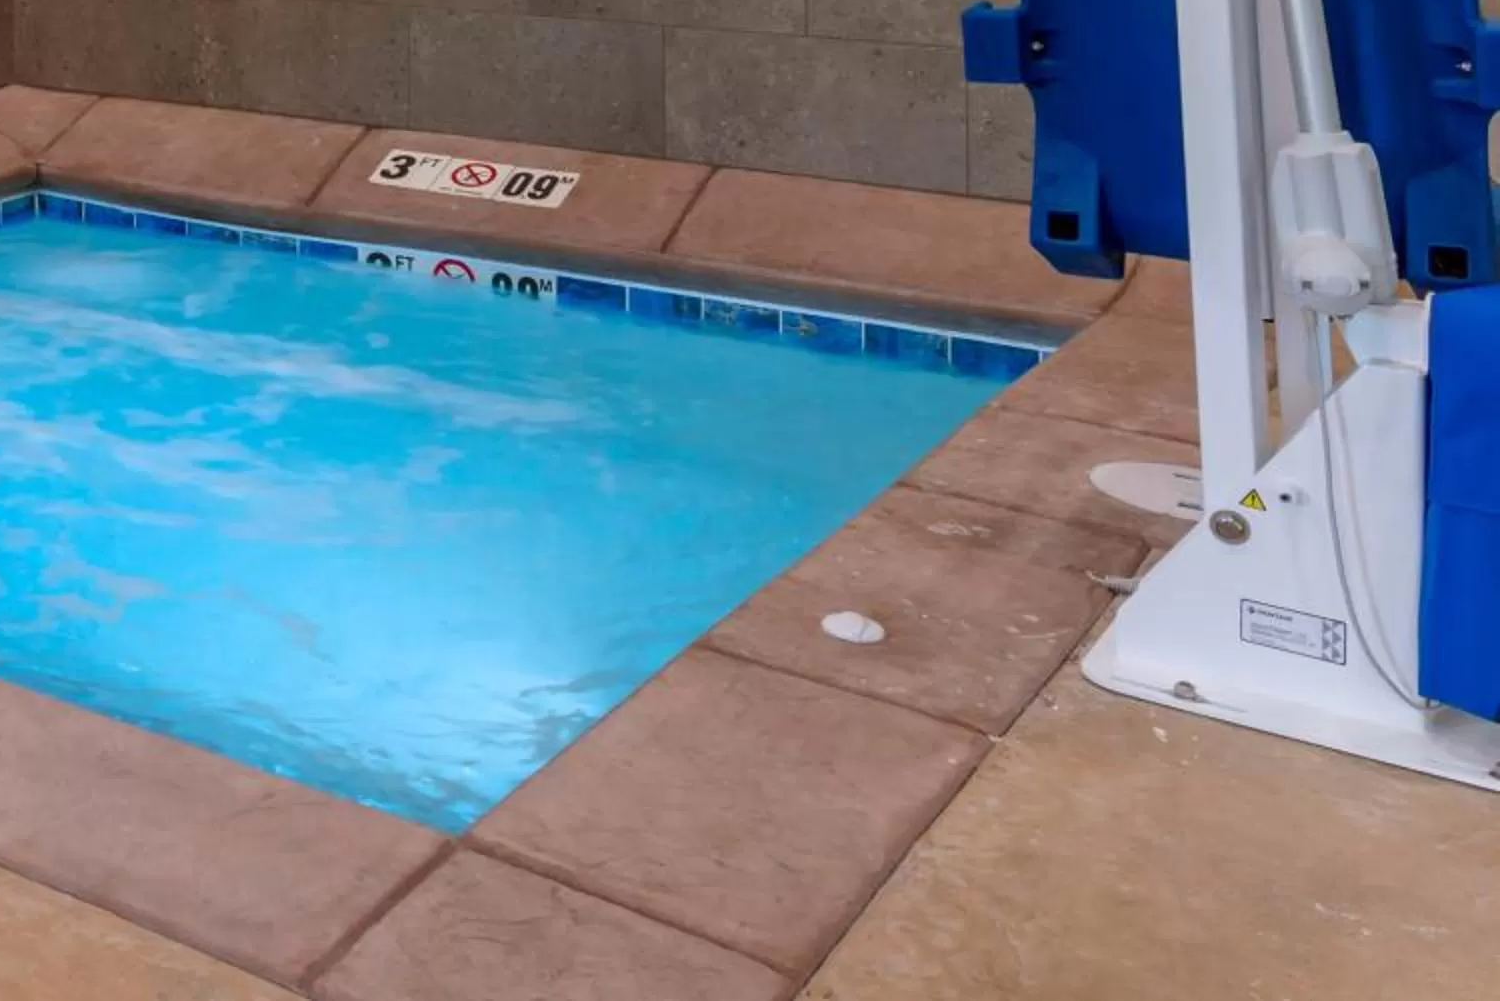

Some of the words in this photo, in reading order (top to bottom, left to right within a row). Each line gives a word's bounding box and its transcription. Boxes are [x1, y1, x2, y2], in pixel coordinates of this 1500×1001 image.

[380, 155, 416, 179] 3
[419, 156, 445, 167] FT
[395, 255, 415, 272] FT
